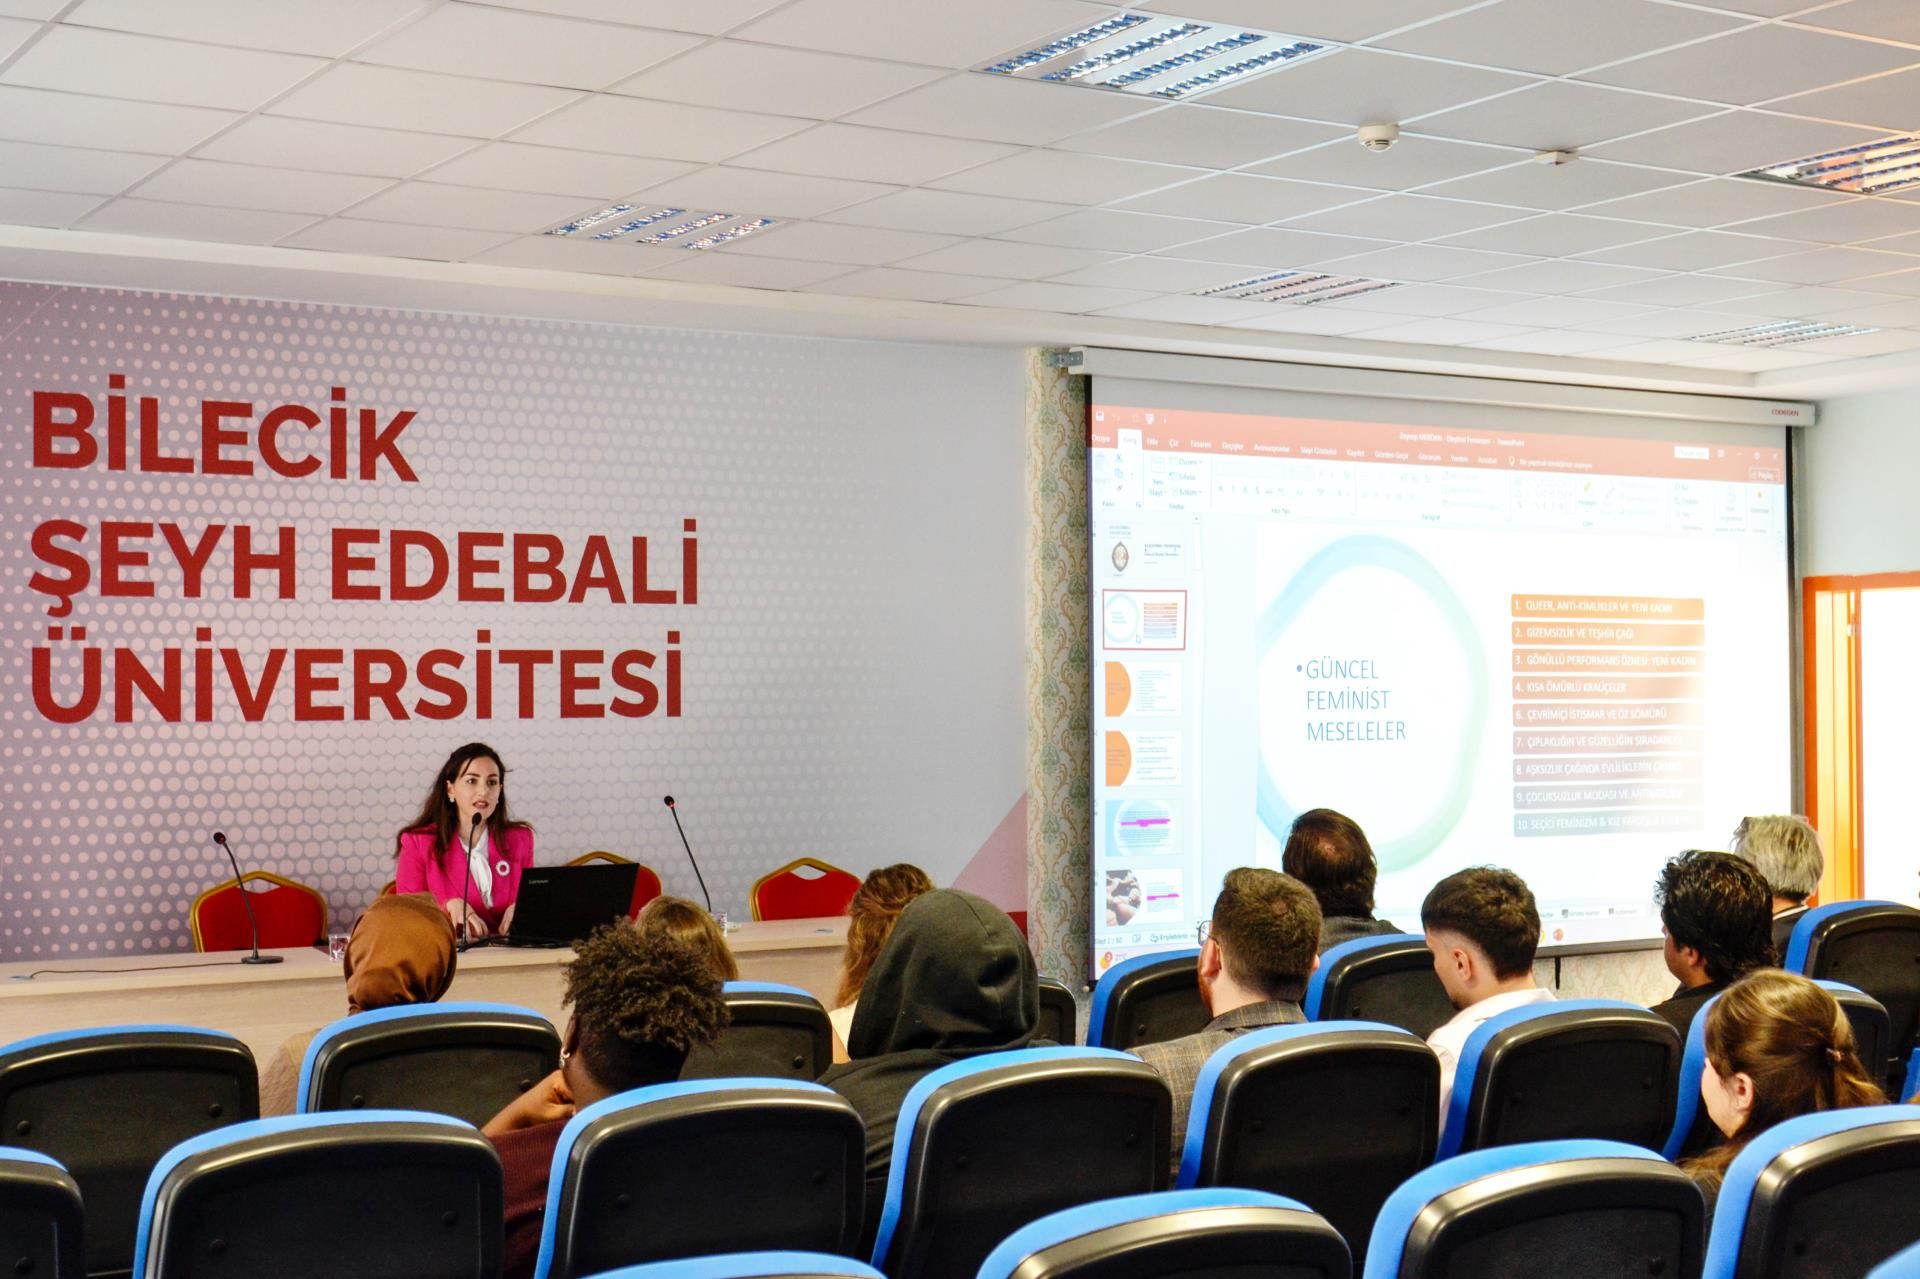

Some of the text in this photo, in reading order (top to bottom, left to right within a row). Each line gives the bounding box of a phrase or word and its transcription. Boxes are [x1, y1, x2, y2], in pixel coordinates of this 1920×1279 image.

[32, 374, 420, 482] BİLECİK
[28, 518, 698, 617] ŞEYH EDEBALİ
[31, 626, 681, 723] ÜNİVERSİTESİ
[1306, 656, 1379, 679] GÜNCEL
[1307, 686, 1391, 710] FEMİNİST
[1307, 721, 1406, 742] MESELELER
